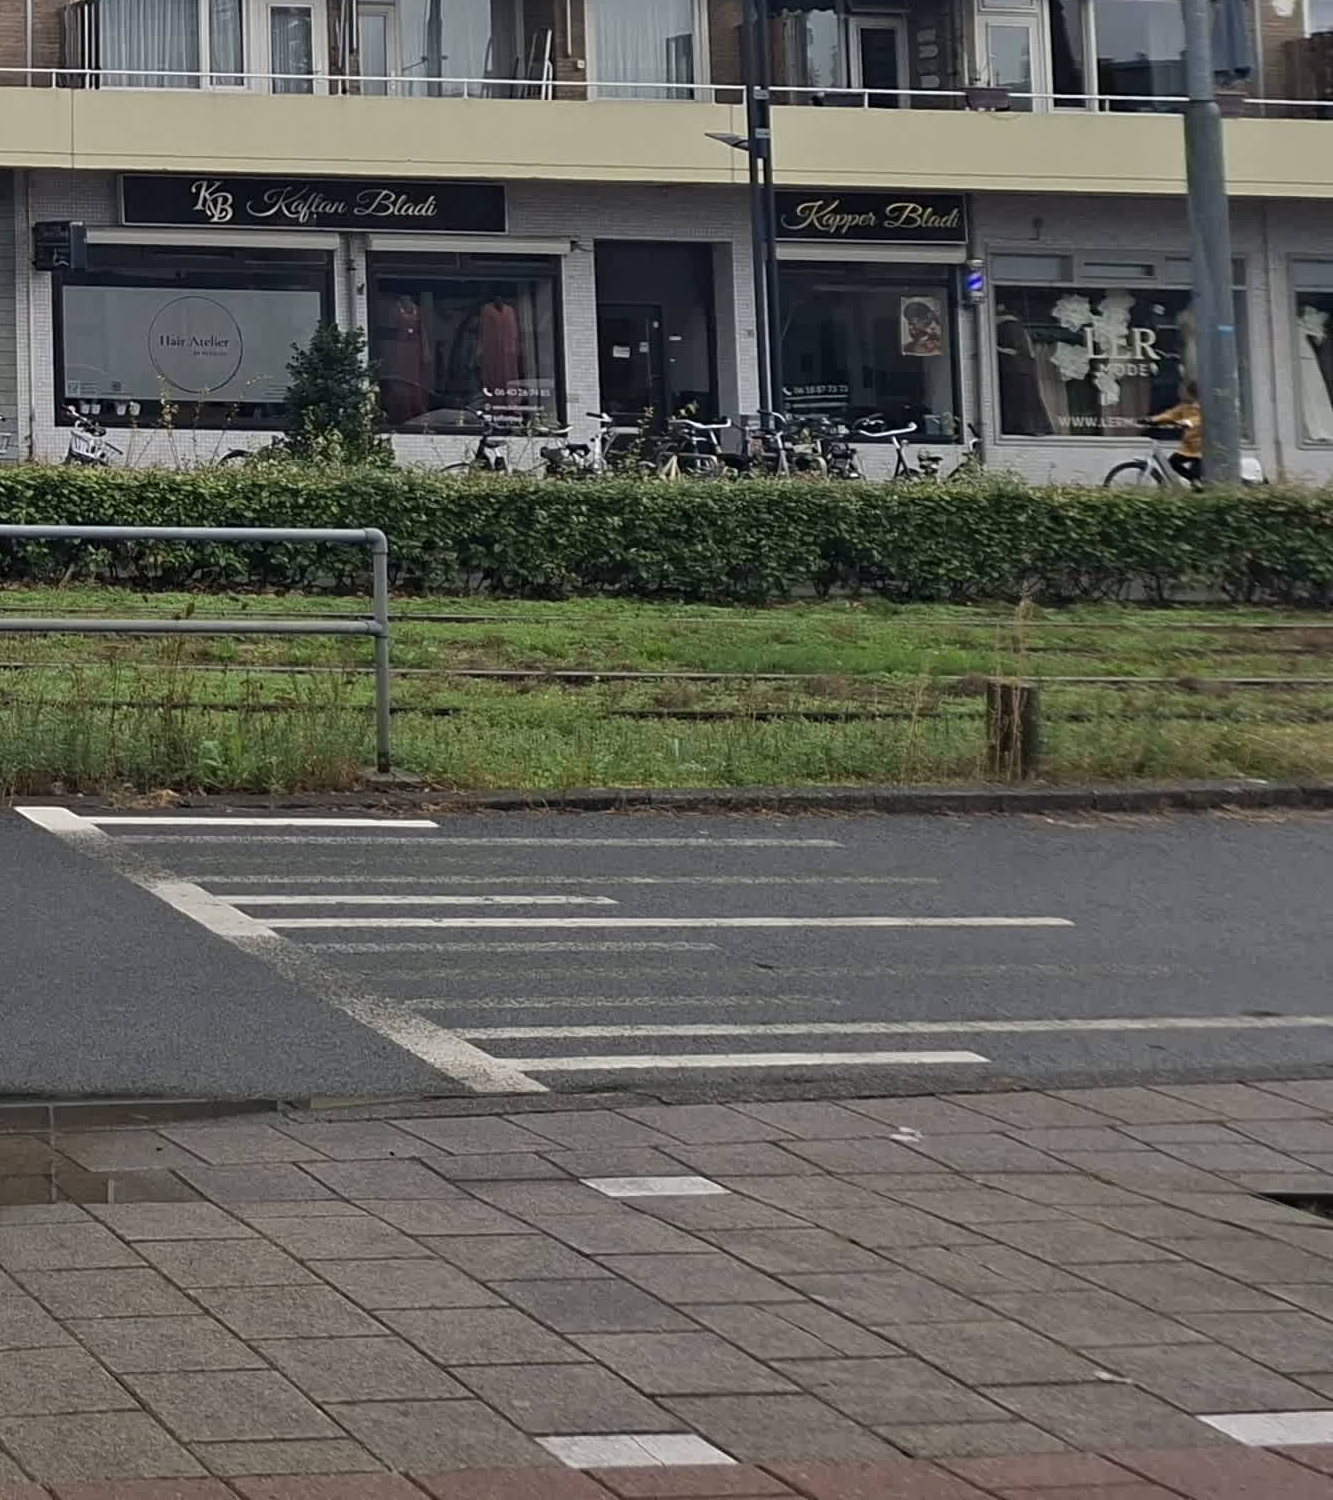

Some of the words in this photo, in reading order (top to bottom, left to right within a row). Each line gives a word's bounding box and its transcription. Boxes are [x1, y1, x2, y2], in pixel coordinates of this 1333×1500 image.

[191, 180, 233, 223] KB
[246, 185, 347, 223] Kaftan
[354, 188, 437, 218] Bladi
[781, 200, 877, 235] Kapper
[884, 202, 960, 229] Bladi
[159, 334, 186, 348] Hair
[187, 335, 230, 348] Atelier
[1085, 327, 1162, 360] LER
[1101, 363, 1149, 377] MODE
